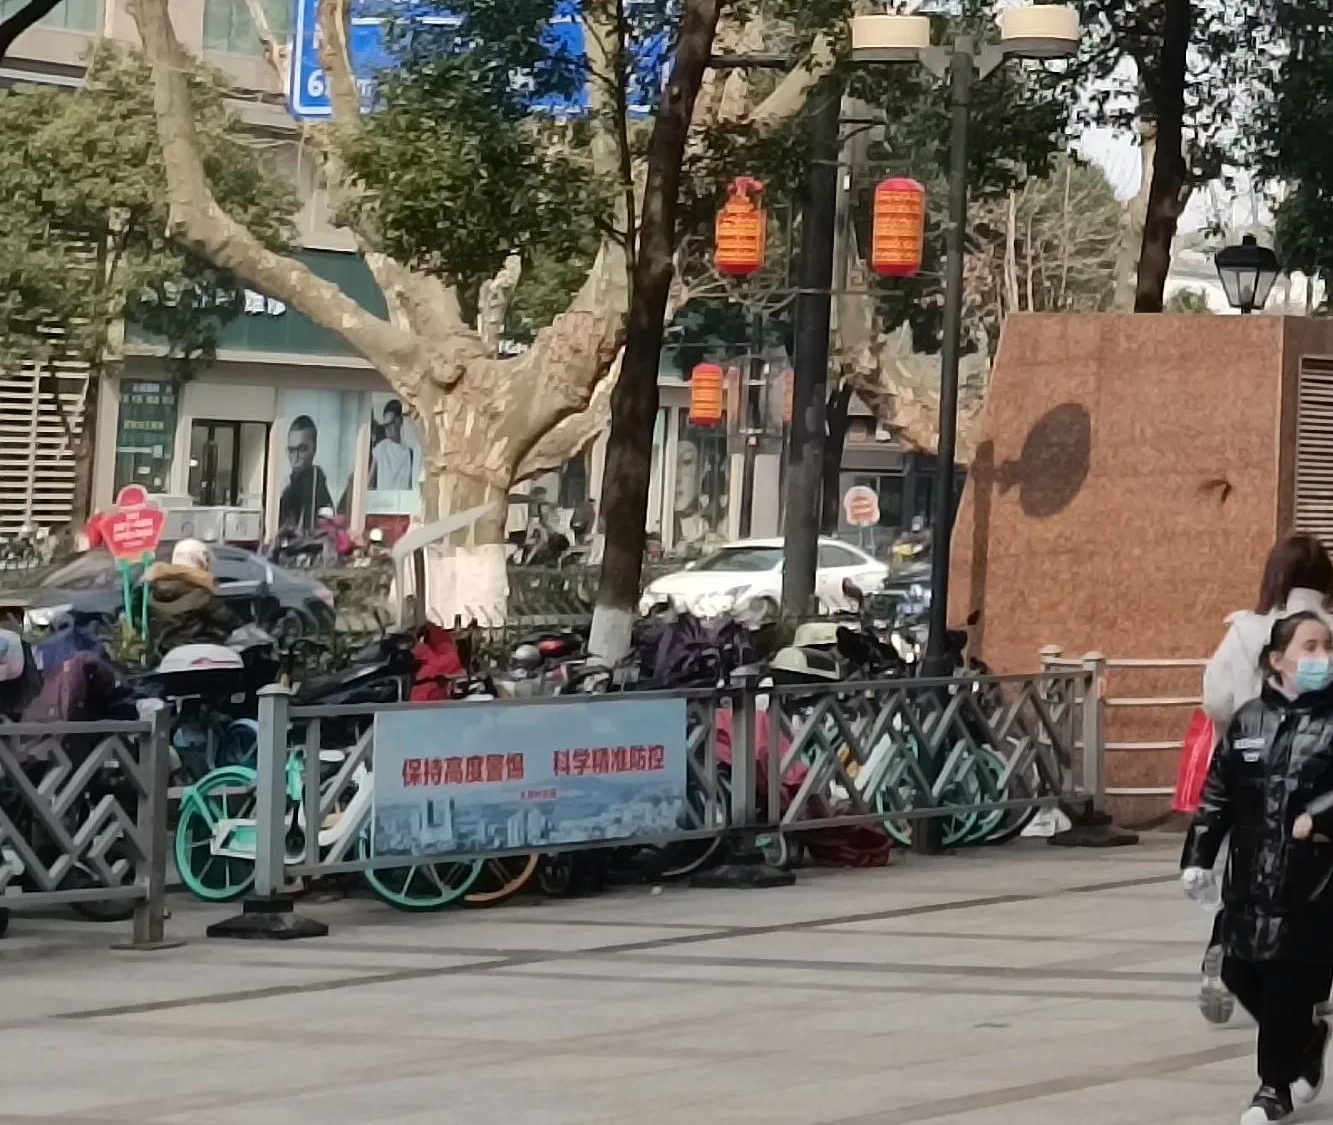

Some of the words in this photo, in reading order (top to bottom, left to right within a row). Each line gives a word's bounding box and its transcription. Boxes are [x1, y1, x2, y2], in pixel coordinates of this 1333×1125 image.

[402, 752, 524, 787] 保持高度警惕
[553, 744, 665, 777] 科学精准防控
